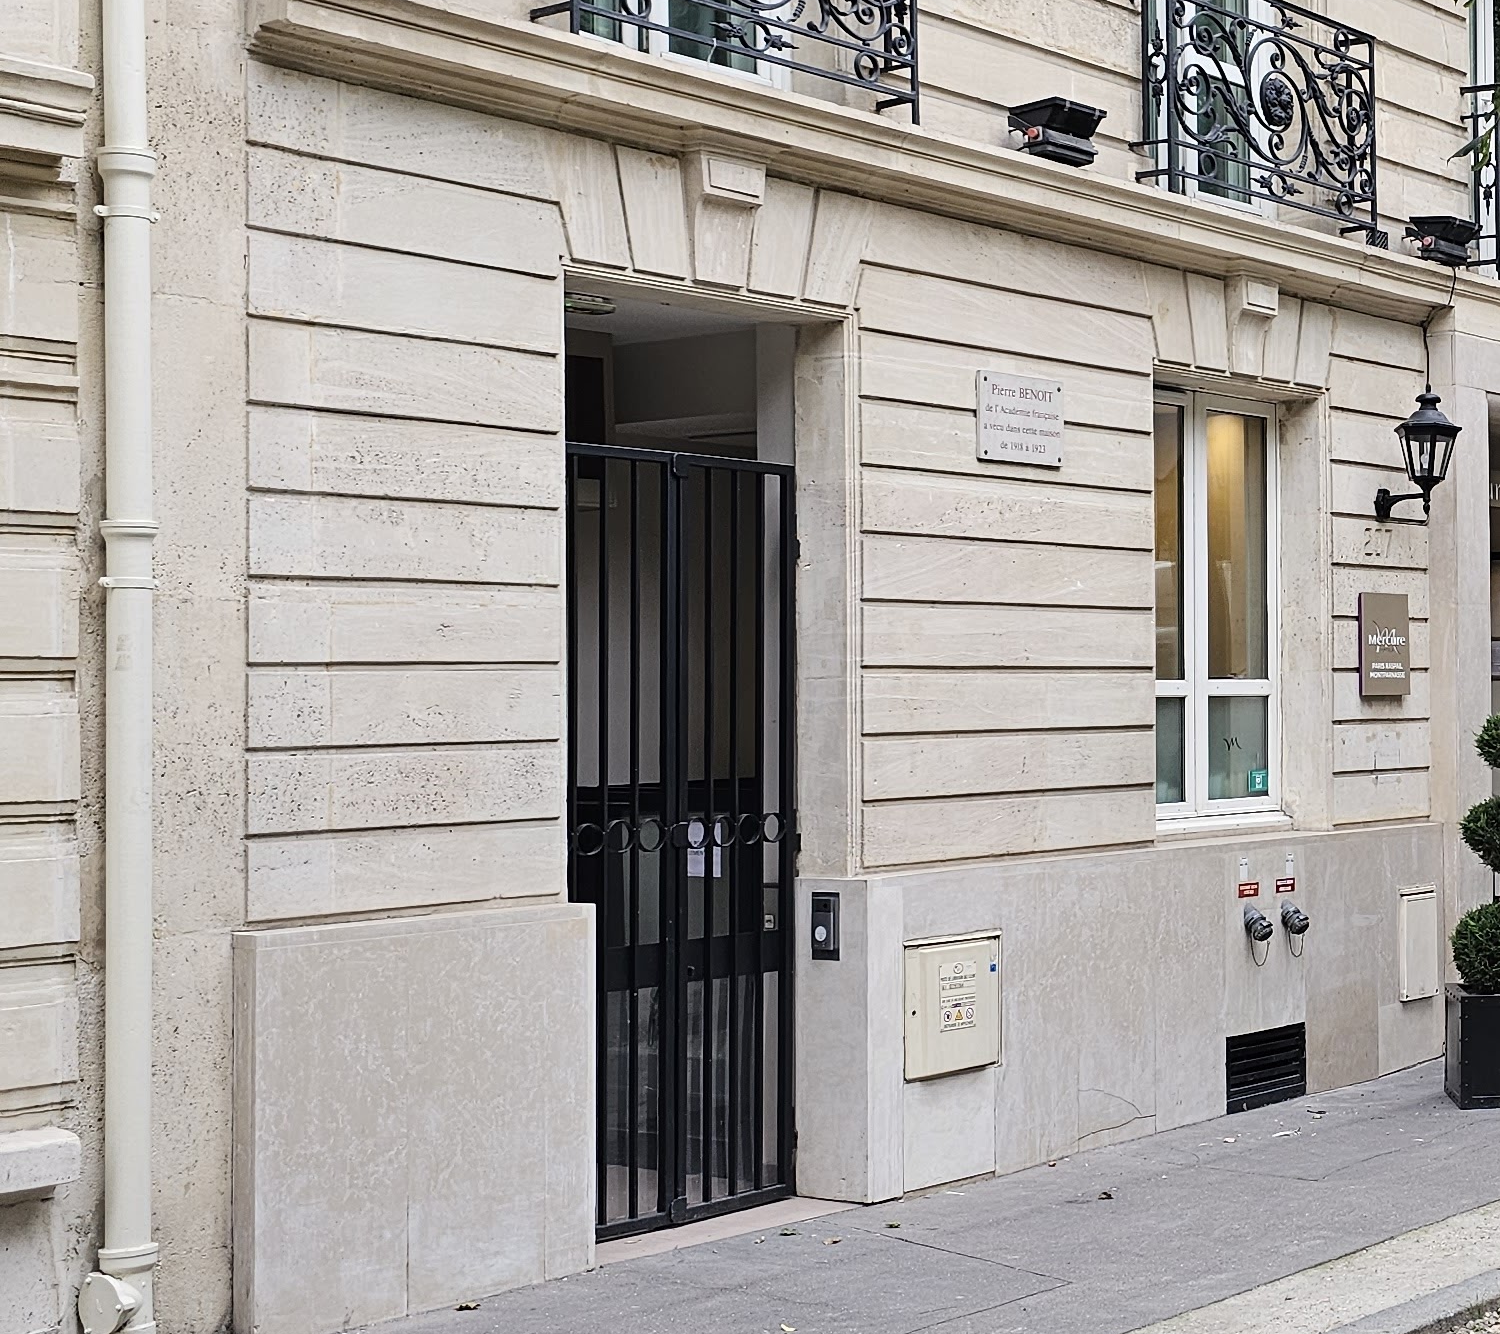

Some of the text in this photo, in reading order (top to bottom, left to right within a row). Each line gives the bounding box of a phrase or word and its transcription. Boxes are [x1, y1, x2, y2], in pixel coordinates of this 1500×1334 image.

[991, 383, 1053, 403] Pierre BENOIT
[985, 403, 993, 413] de
[1006, 424, 1020, 433] dans
[1022, 427, 1037, 435] cette
[1039, 429, 1061, 438] maison
[1000, 440, 1009, 449] de
[1011, 441, 1024, 451] 1918
[1032, 443, 1047, 454] 1923
[1368, 634, 1406, 646] Mercure
